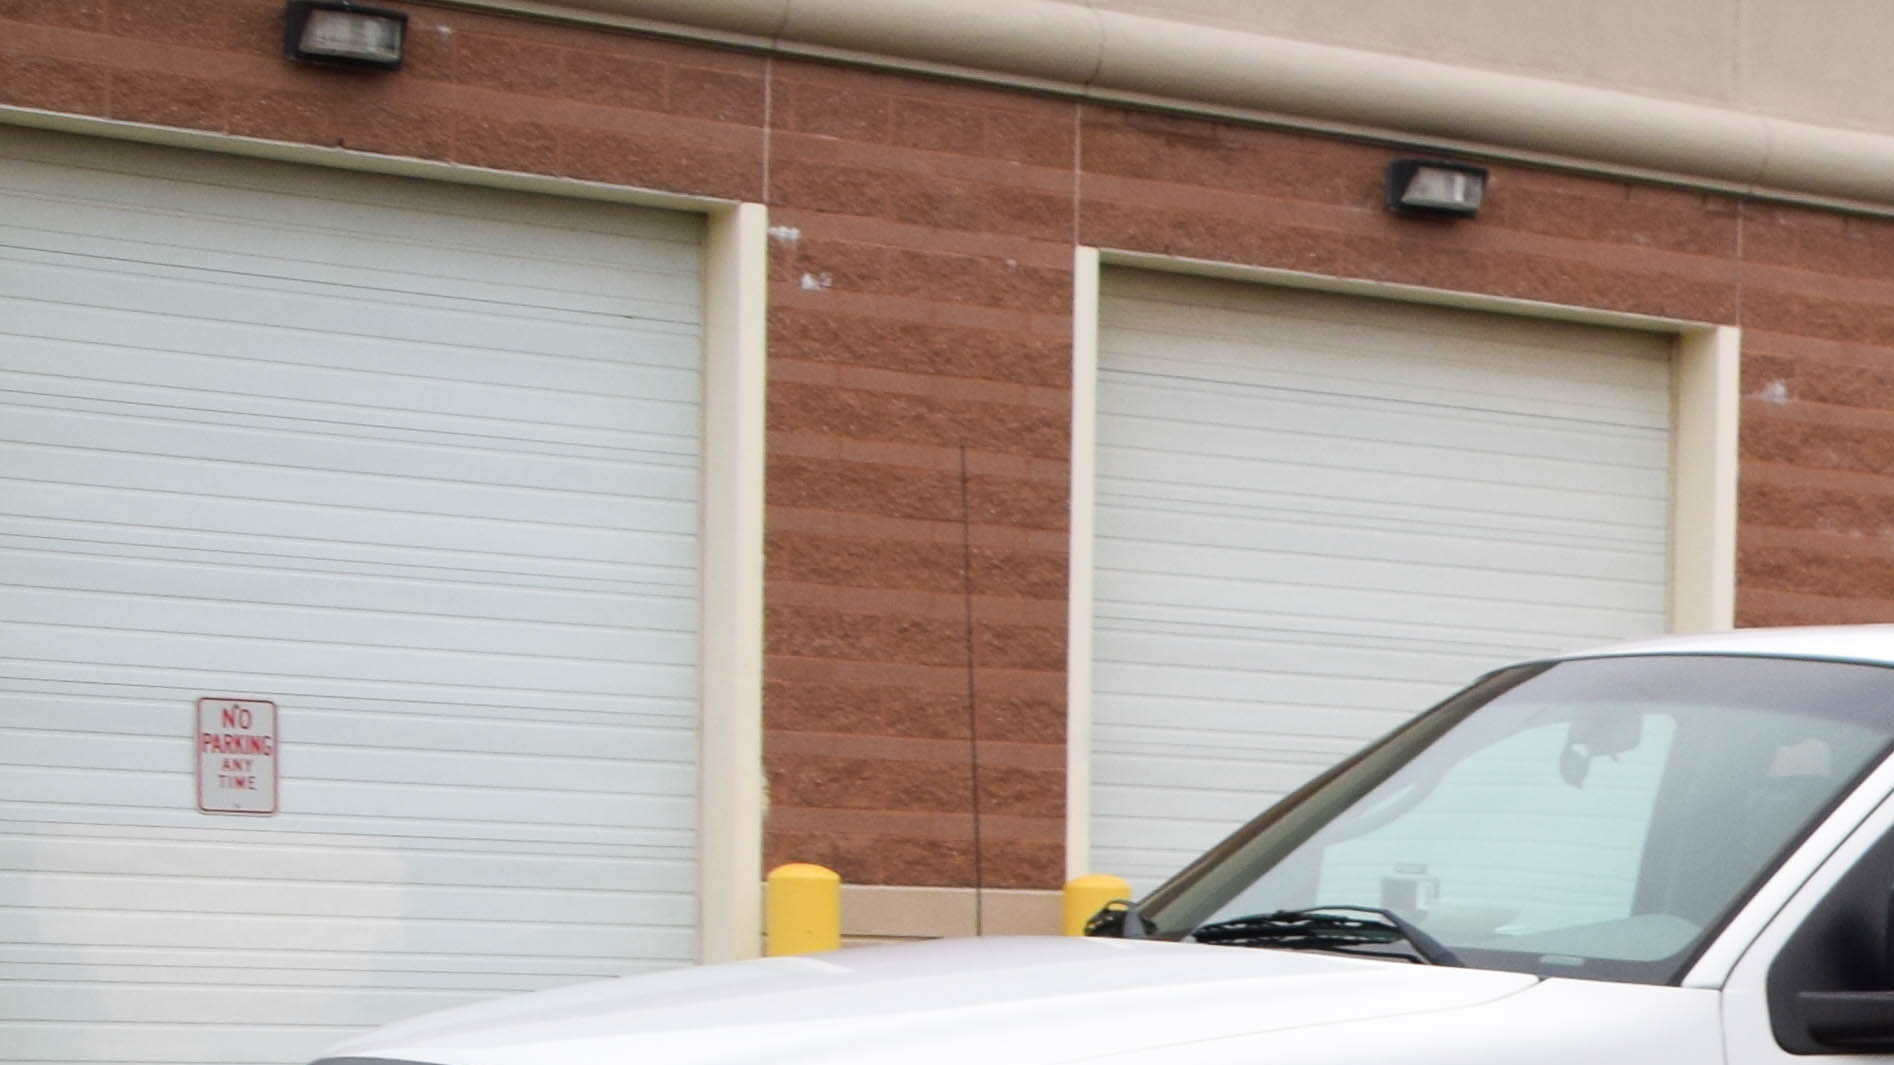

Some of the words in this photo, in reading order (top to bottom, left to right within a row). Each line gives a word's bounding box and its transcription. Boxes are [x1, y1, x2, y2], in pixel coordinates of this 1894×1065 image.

[222, 708, 252, 729] NO
[200, 733, 272, 755] PARKING
[223, 759, 252, 772] ANY
[218, 775, 257, 790] TIME
